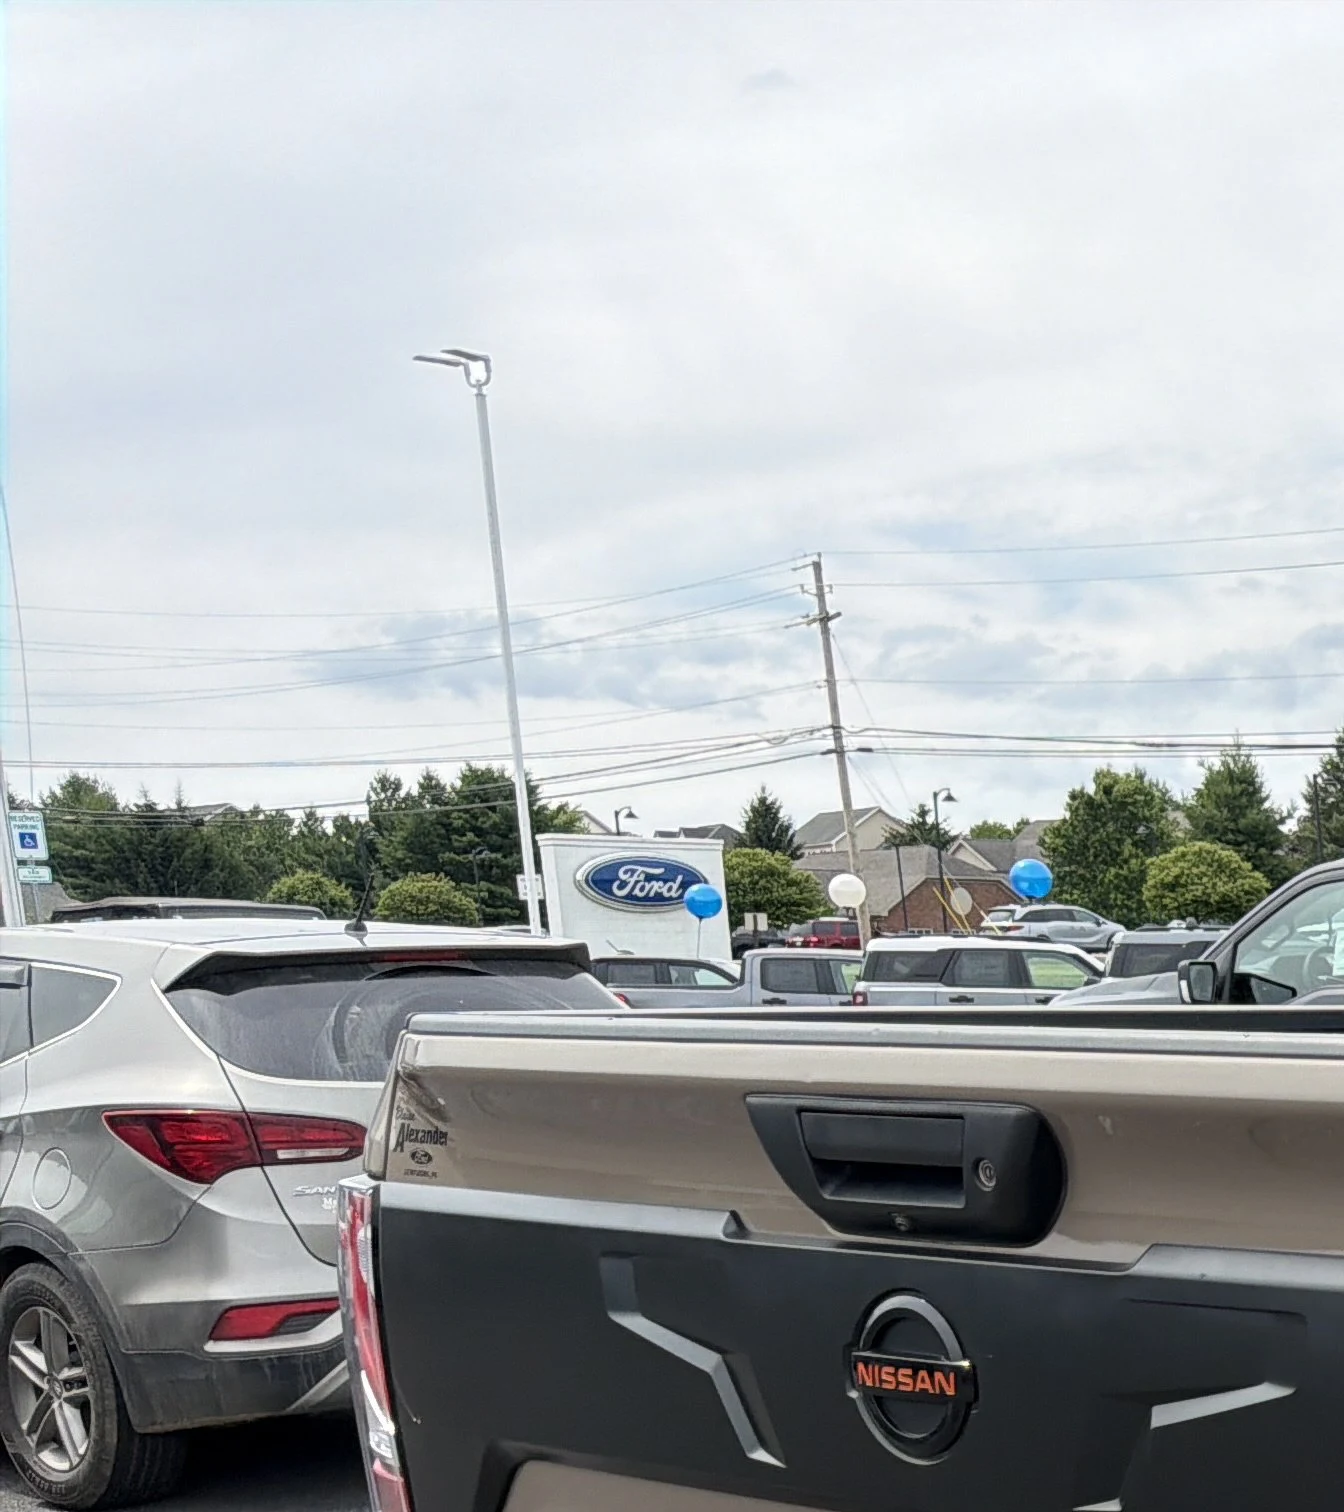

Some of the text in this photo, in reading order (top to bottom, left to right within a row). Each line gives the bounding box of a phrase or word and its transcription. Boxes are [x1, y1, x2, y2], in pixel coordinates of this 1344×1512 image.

[612, 864, 682, 899] Ford
[393, 1122, 448, 1153] Alexander
[292, 1185, 336, 1197] SAN
[856, 1361, 957, 1396] NISSAN
